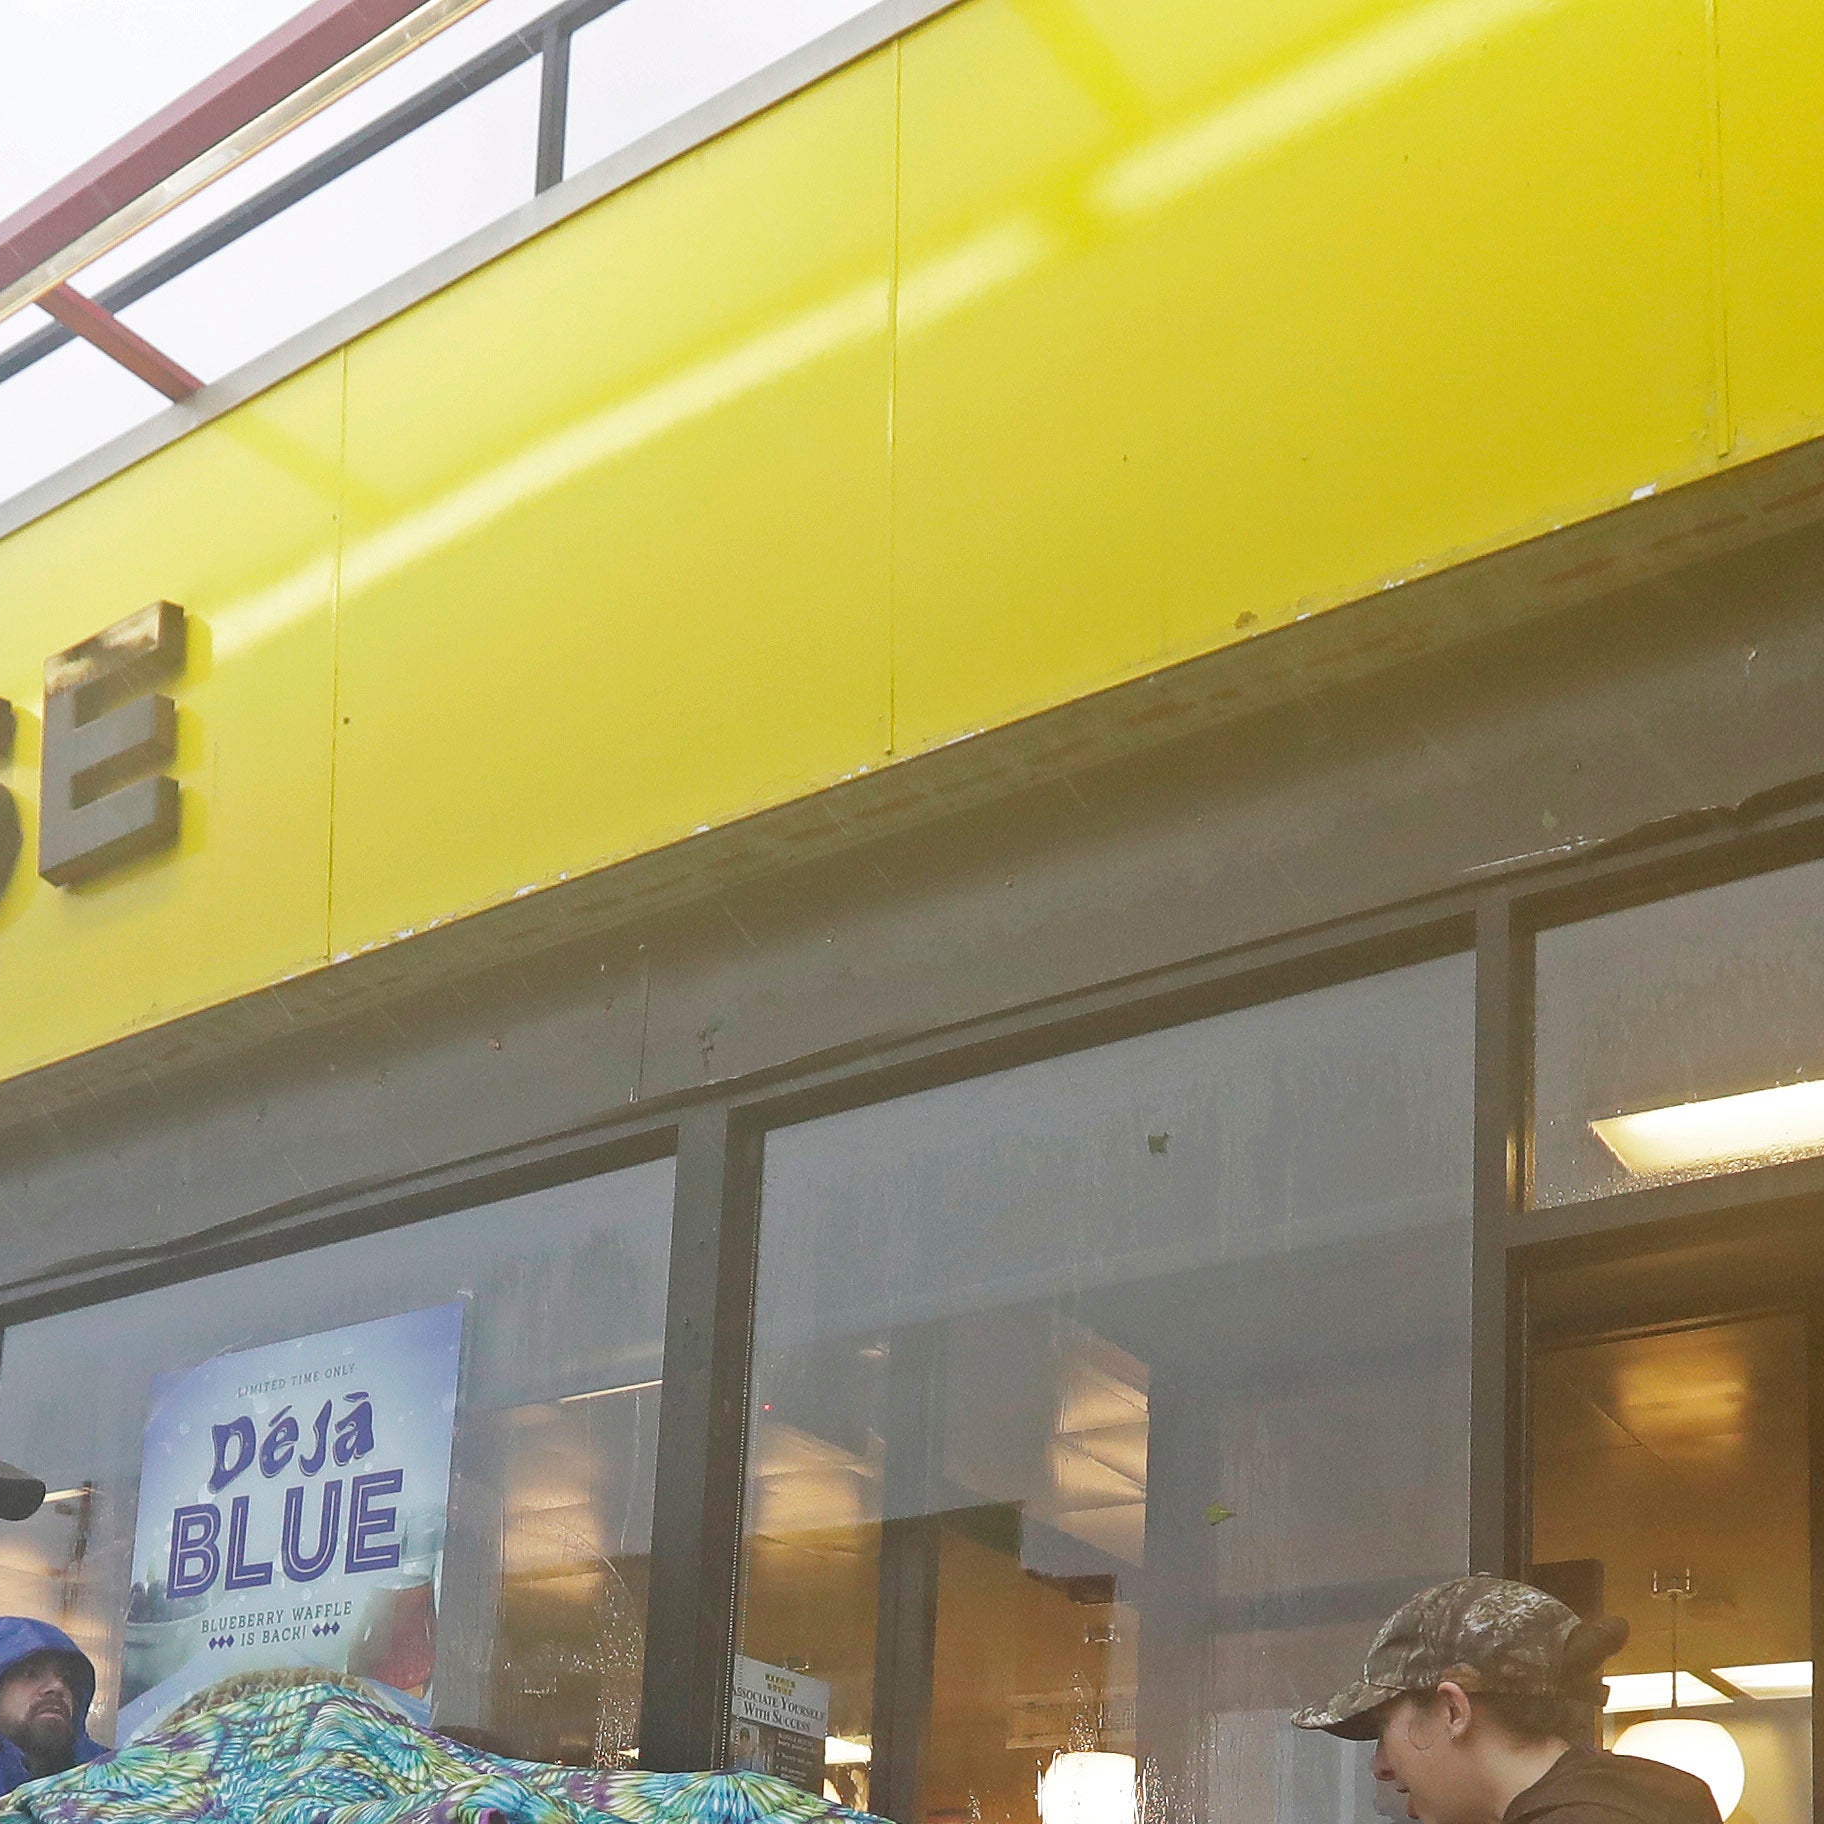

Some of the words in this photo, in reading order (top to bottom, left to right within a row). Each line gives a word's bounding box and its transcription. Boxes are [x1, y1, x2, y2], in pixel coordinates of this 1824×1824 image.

[237, 1378, 286, 1399] LIMITED
[291, 1370, 320, 1386] TIME
[324, 1362, 356, 1379] ONLY
[166, 1468, 404, 1600] BLUE
[201, 1609, 284, 1633] BLUEBERRY
[292, 1601, 352, 1621] WAFFLE
[241, 1632, 255, 1646] IS
[262, 1625, 306, 1644] BACK!
